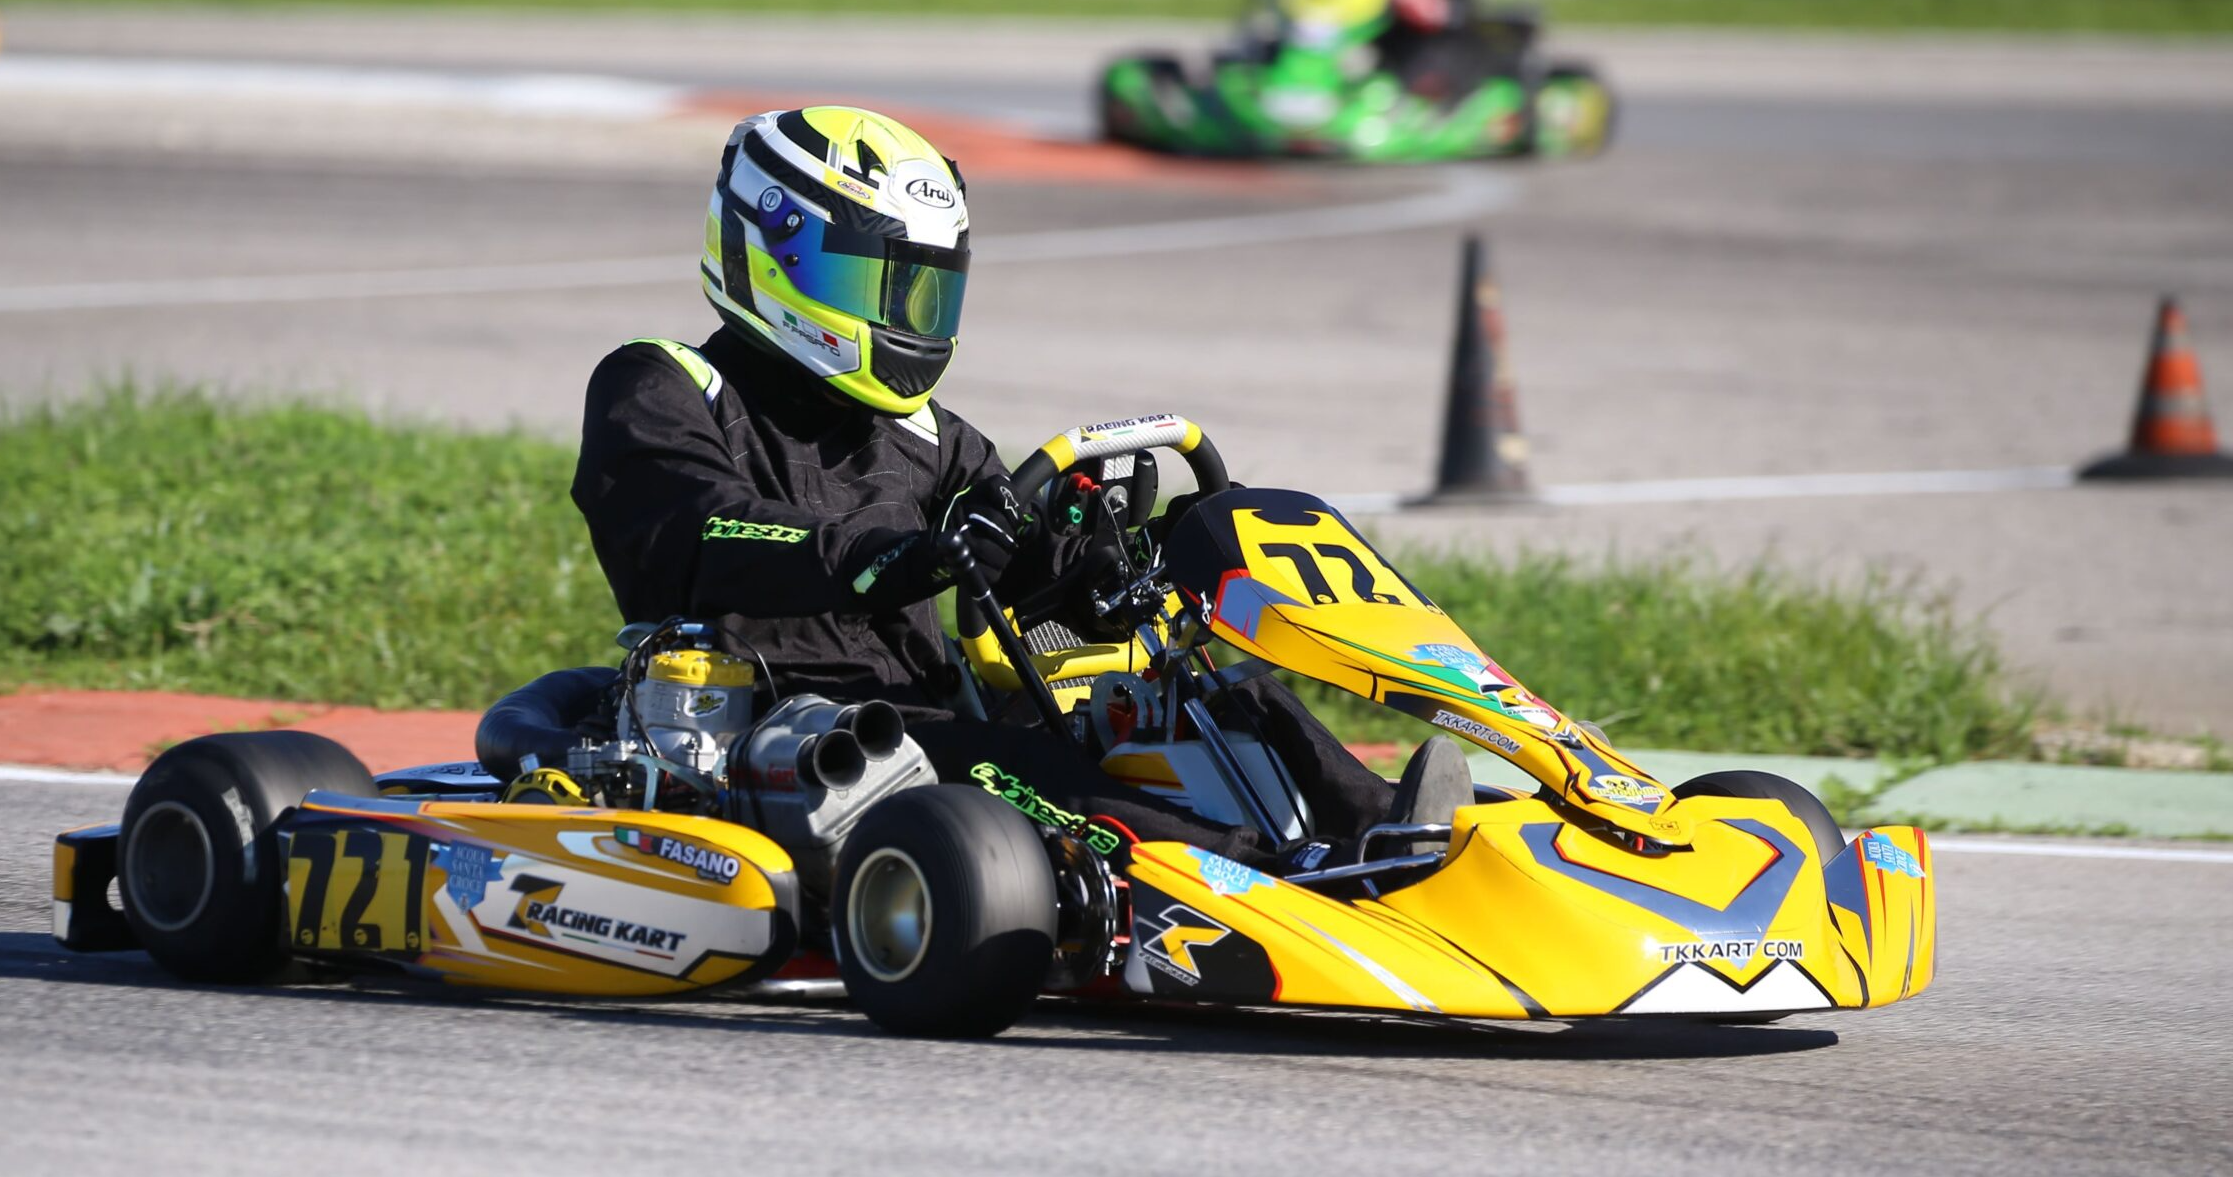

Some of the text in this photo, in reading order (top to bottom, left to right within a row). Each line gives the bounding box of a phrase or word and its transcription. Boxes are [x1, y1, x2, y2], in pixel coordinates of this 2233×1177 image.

[914, 181, 951, 200] Arai
[1086, 413, 1175, 433] RACING KART
[456, 847, 485, 866] ACQUA
[660, 837, 739, 877] FASANO
[1208, 854, 1251, 881] SANTA
[451, 860, 484, 878] SANTA
[1204, 864, 1247, 888] CROCE
[290, 831, 430, 952] 721
[448, 875, 481, 892] CROCE
[526, 901, 687, 951] RACING KART
